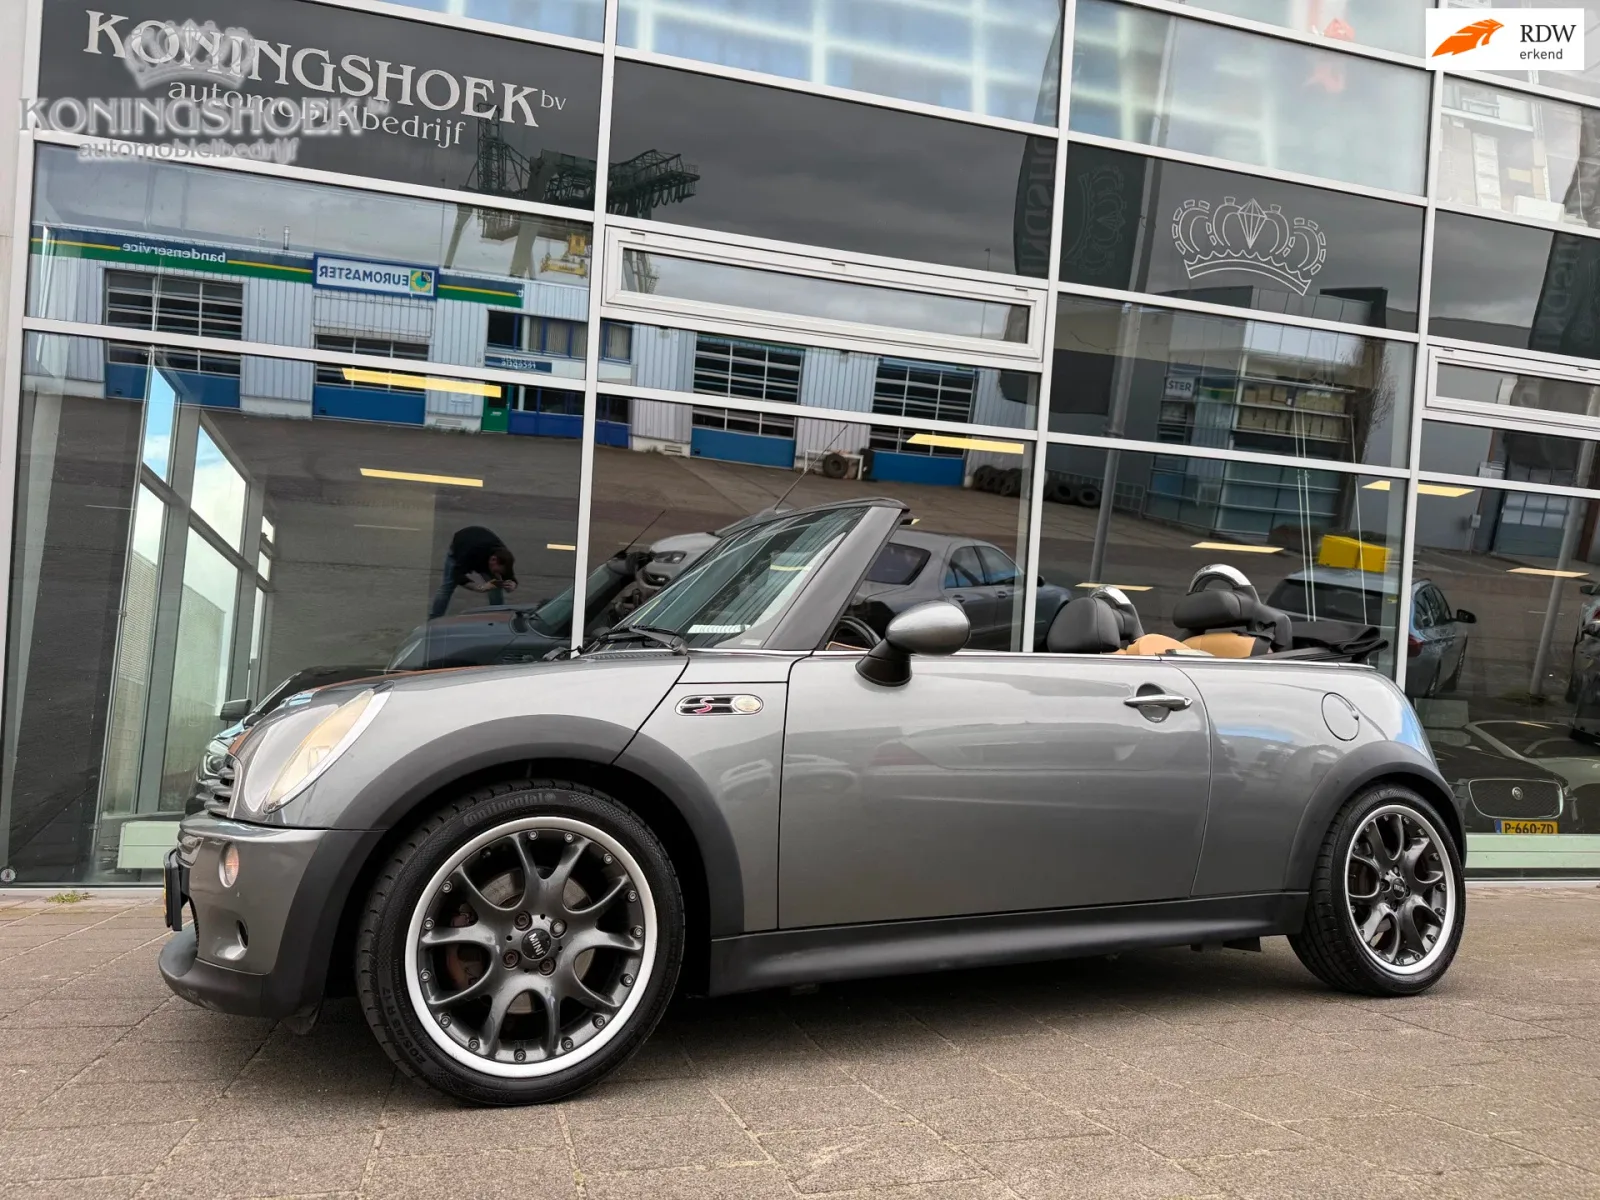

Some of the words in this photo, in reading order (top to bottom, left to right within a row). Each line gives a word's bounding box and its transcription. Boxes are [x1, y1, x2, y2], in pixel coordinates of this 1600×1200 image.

[83, 10, 539, 127] KONINGSHOEK
[541, 89, 567, 110] bv
[463, 793, 543, 826] Continental
[1504, 822, 1554, 834] P-660-ZD
[528, 932, 544, 956] MINI
